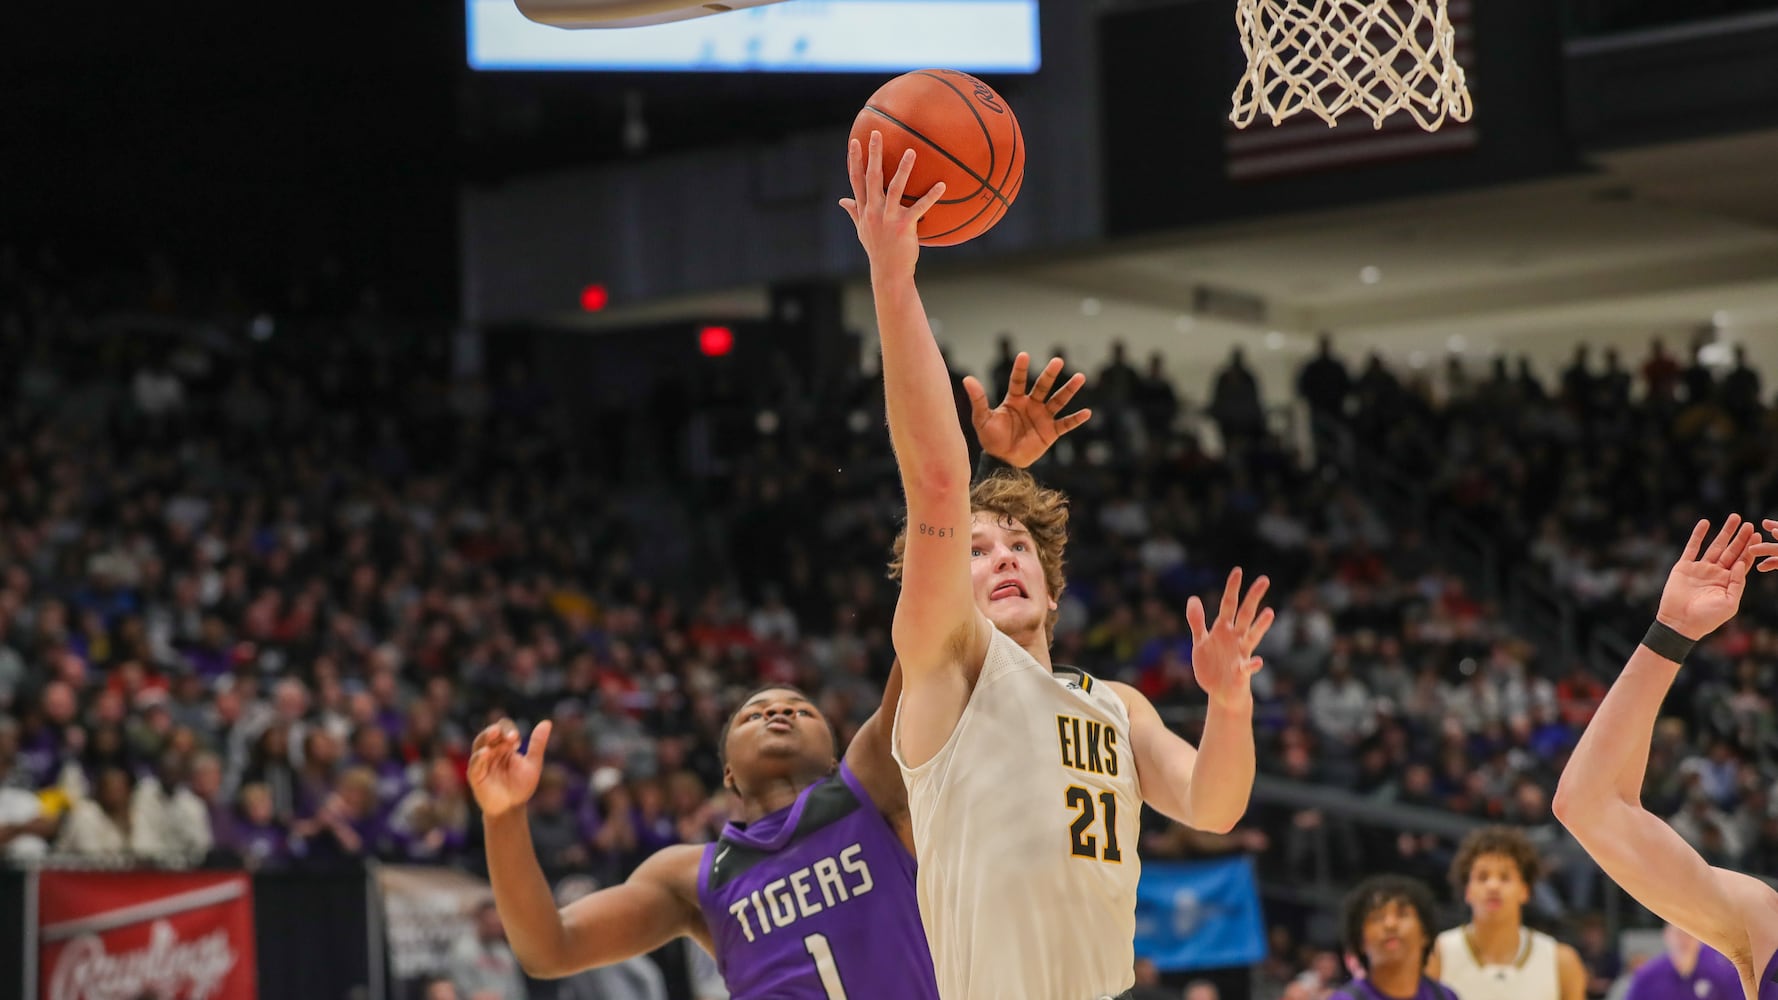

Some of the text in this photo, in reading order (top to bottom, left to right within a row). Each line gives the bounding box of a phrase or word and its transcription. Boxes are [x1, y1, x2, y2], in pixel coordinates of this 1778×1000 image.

[1056, 714, 1119, 777] ELKS
[1063, 783, 1123, 864] 21
[729, 843, 874, 942] TIGERS
[804, 933, 848, 1000] 1
